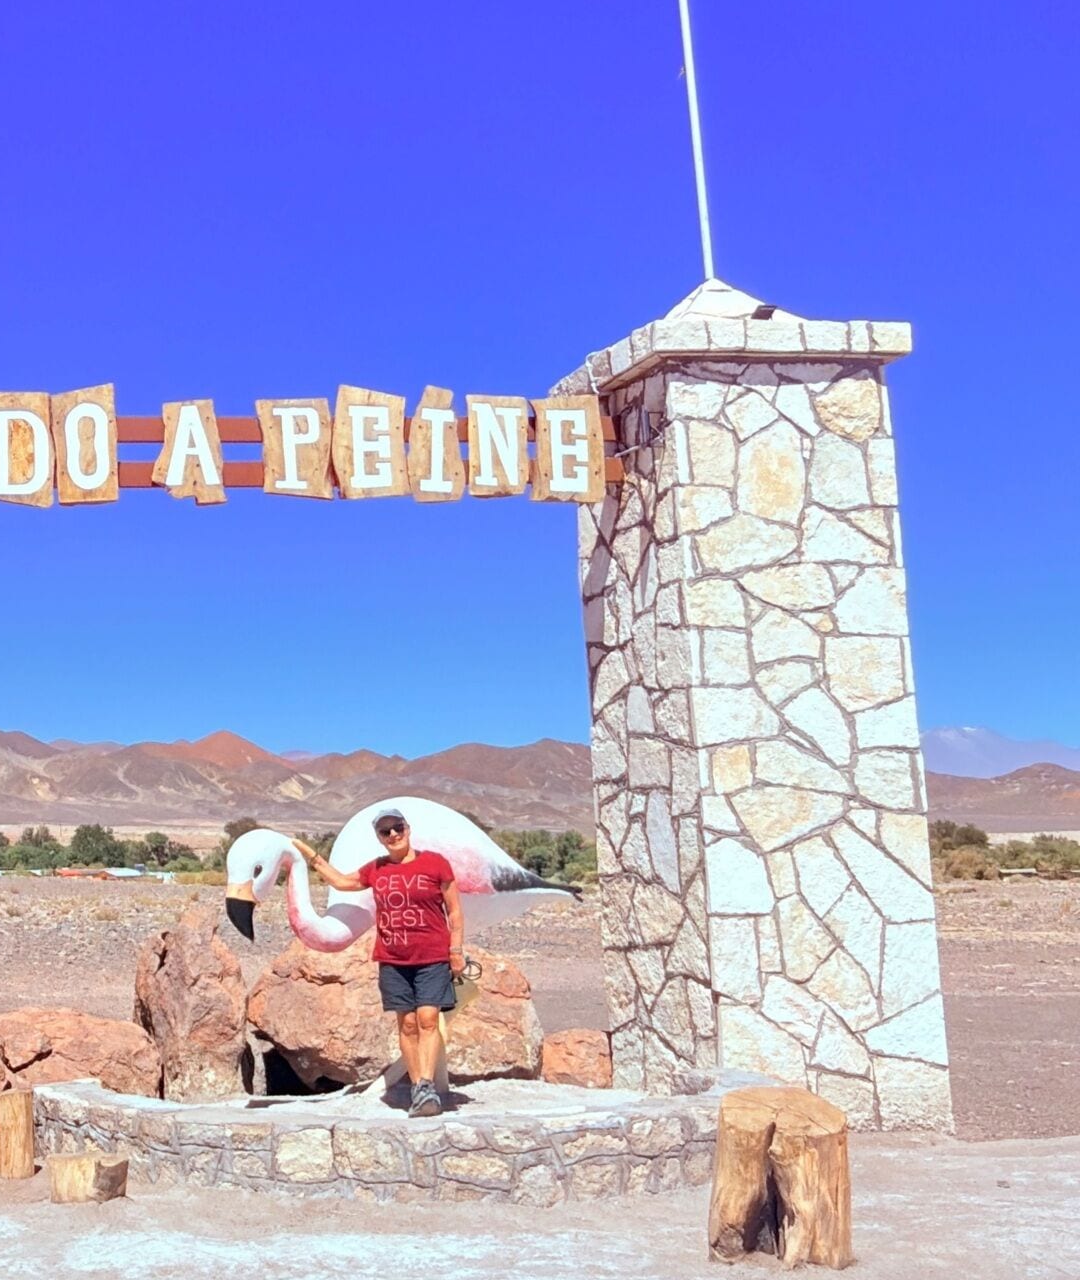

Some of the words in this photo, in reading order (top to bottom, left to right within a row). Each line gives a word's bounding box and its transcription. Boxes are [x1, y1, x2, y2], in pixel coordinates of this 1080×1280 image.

[165, 405, 221, 487] A
[272, 402, 590, 493] PEINE
[375, 874, 430, 891] CEVE
[376, 890, 418, 910] NOL
[379, 909, 427, 929] DESI
